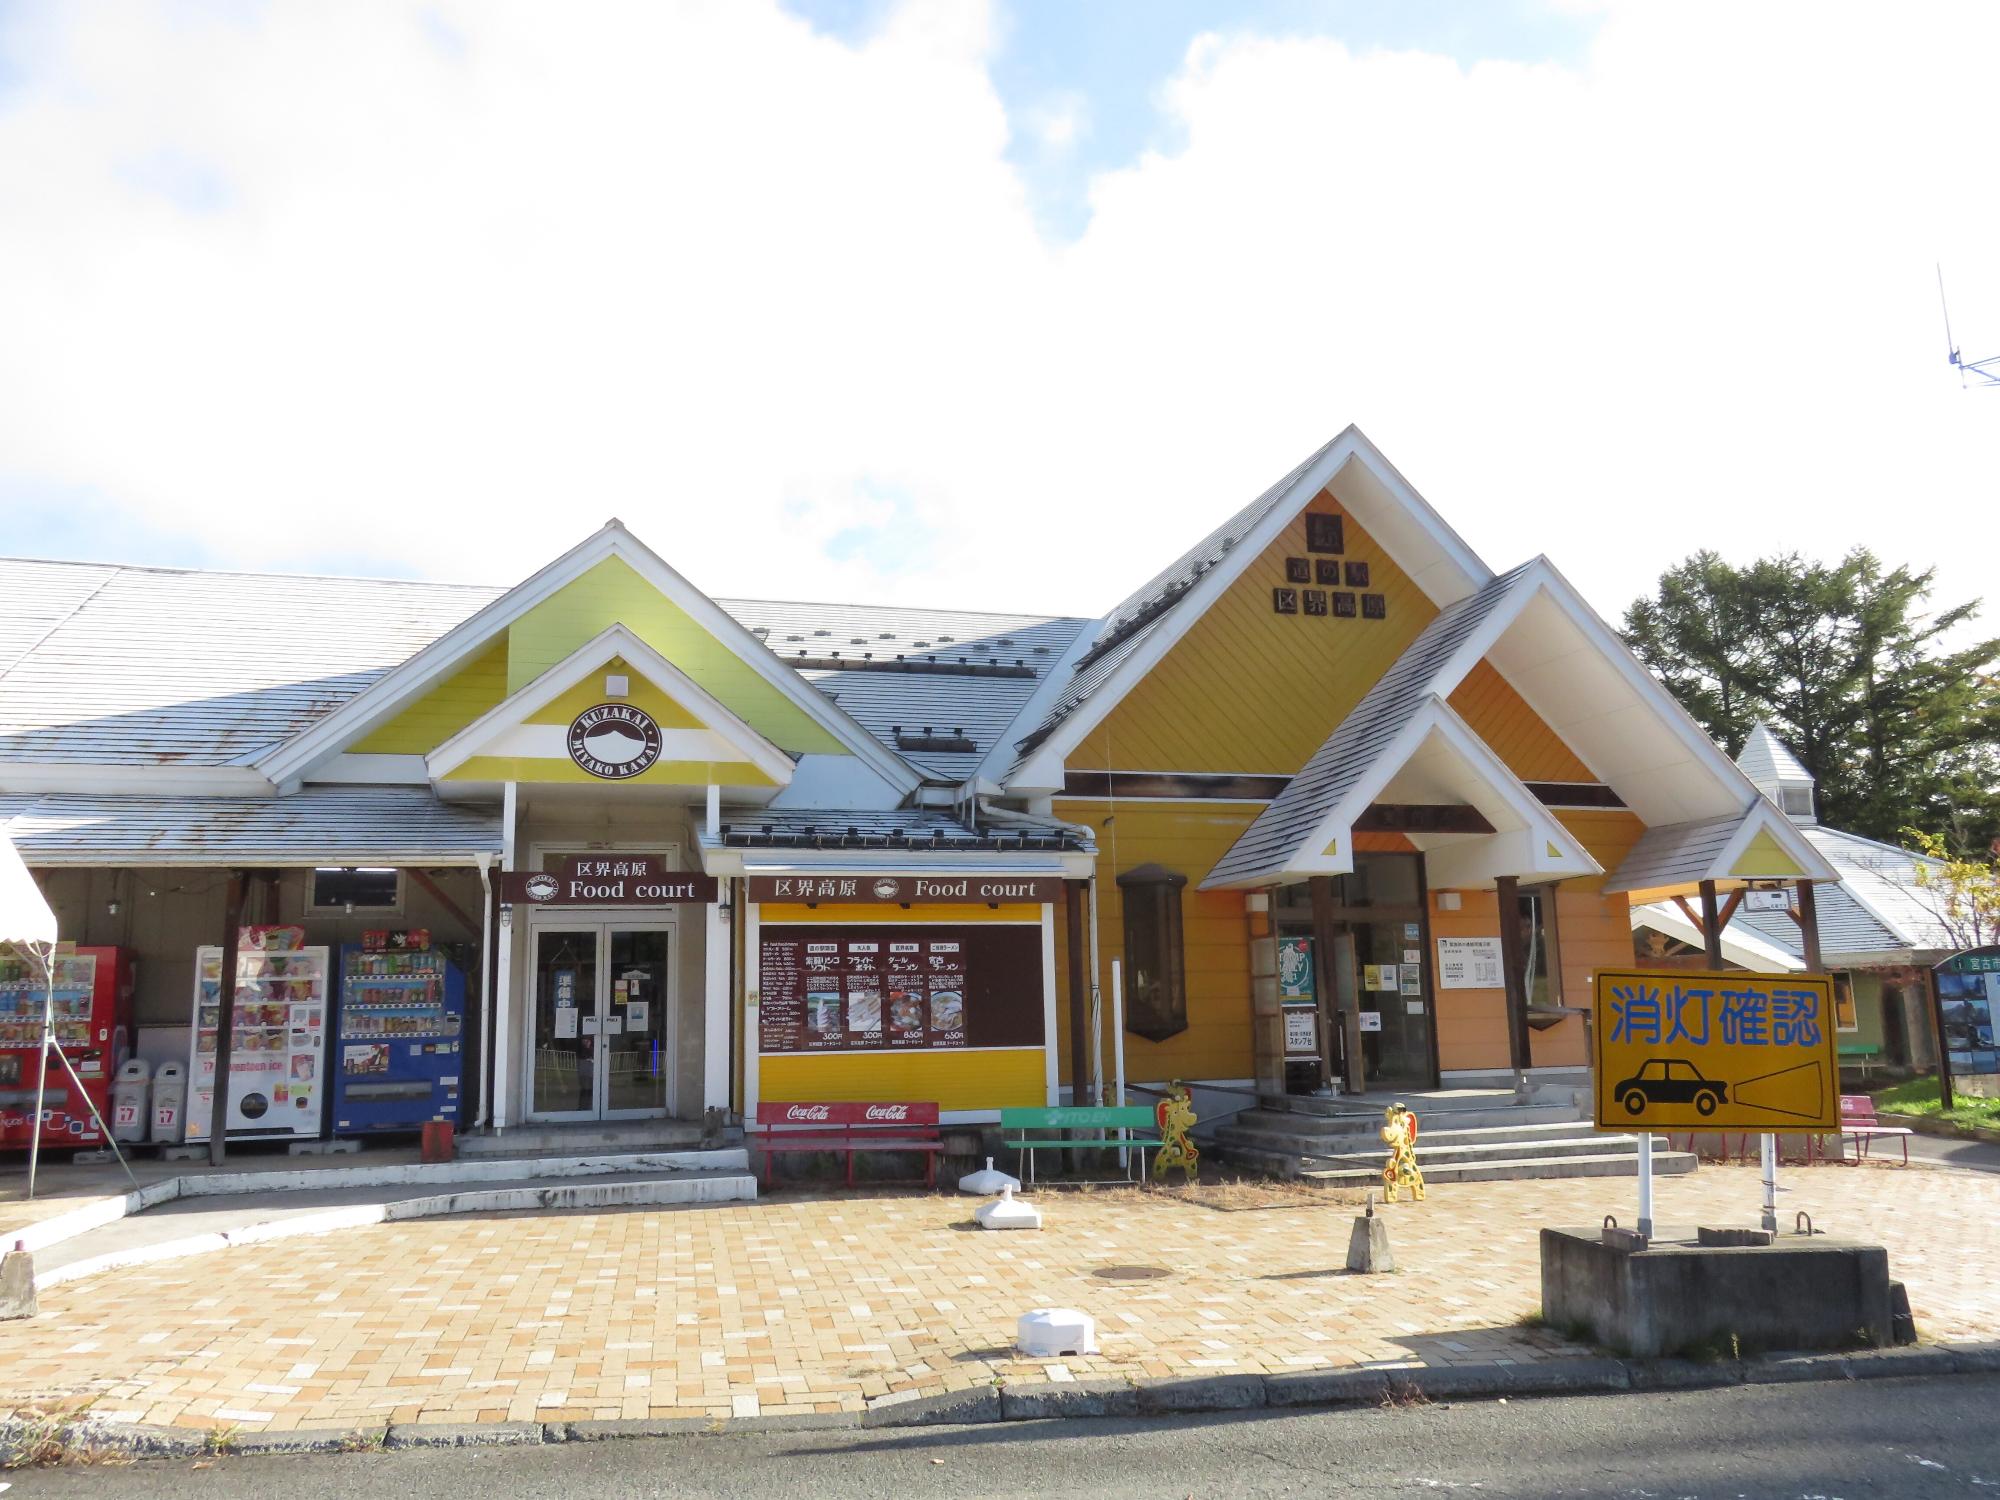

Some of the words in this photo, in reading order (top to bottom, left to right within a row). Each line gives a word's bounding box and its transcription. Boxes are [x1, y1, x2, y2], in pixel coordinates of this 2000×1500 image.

[580, 707, 649, 729] KUZAKAI
[572, 739, 613, 775] MIYAKO
[619, 742, 658, 775] KAWAI
[577, 861, 647, 877] 区界高原
[569, 881, 625, 898] Food
[635, 882, 695, 898] court
[775, 879, 857, 897] 区界高原
[915, 880, 968, 897] Food
[980, 881, 1035, 897] court
[811, 964, 831, 972] ソフト
[888, 956, 909, 964] ダール
[892, 963, 919, 972] ラーメン
[933, 963, 959, 971] ラーメン
[1610, 984, 1822, 1048] 消灯確認
[1289, 1037, 1312, 1046] スタンプ台
[786, 1104, 831, 1120] Coca-Cola
[866, 1104, 909, 1120] Coca-Cola
